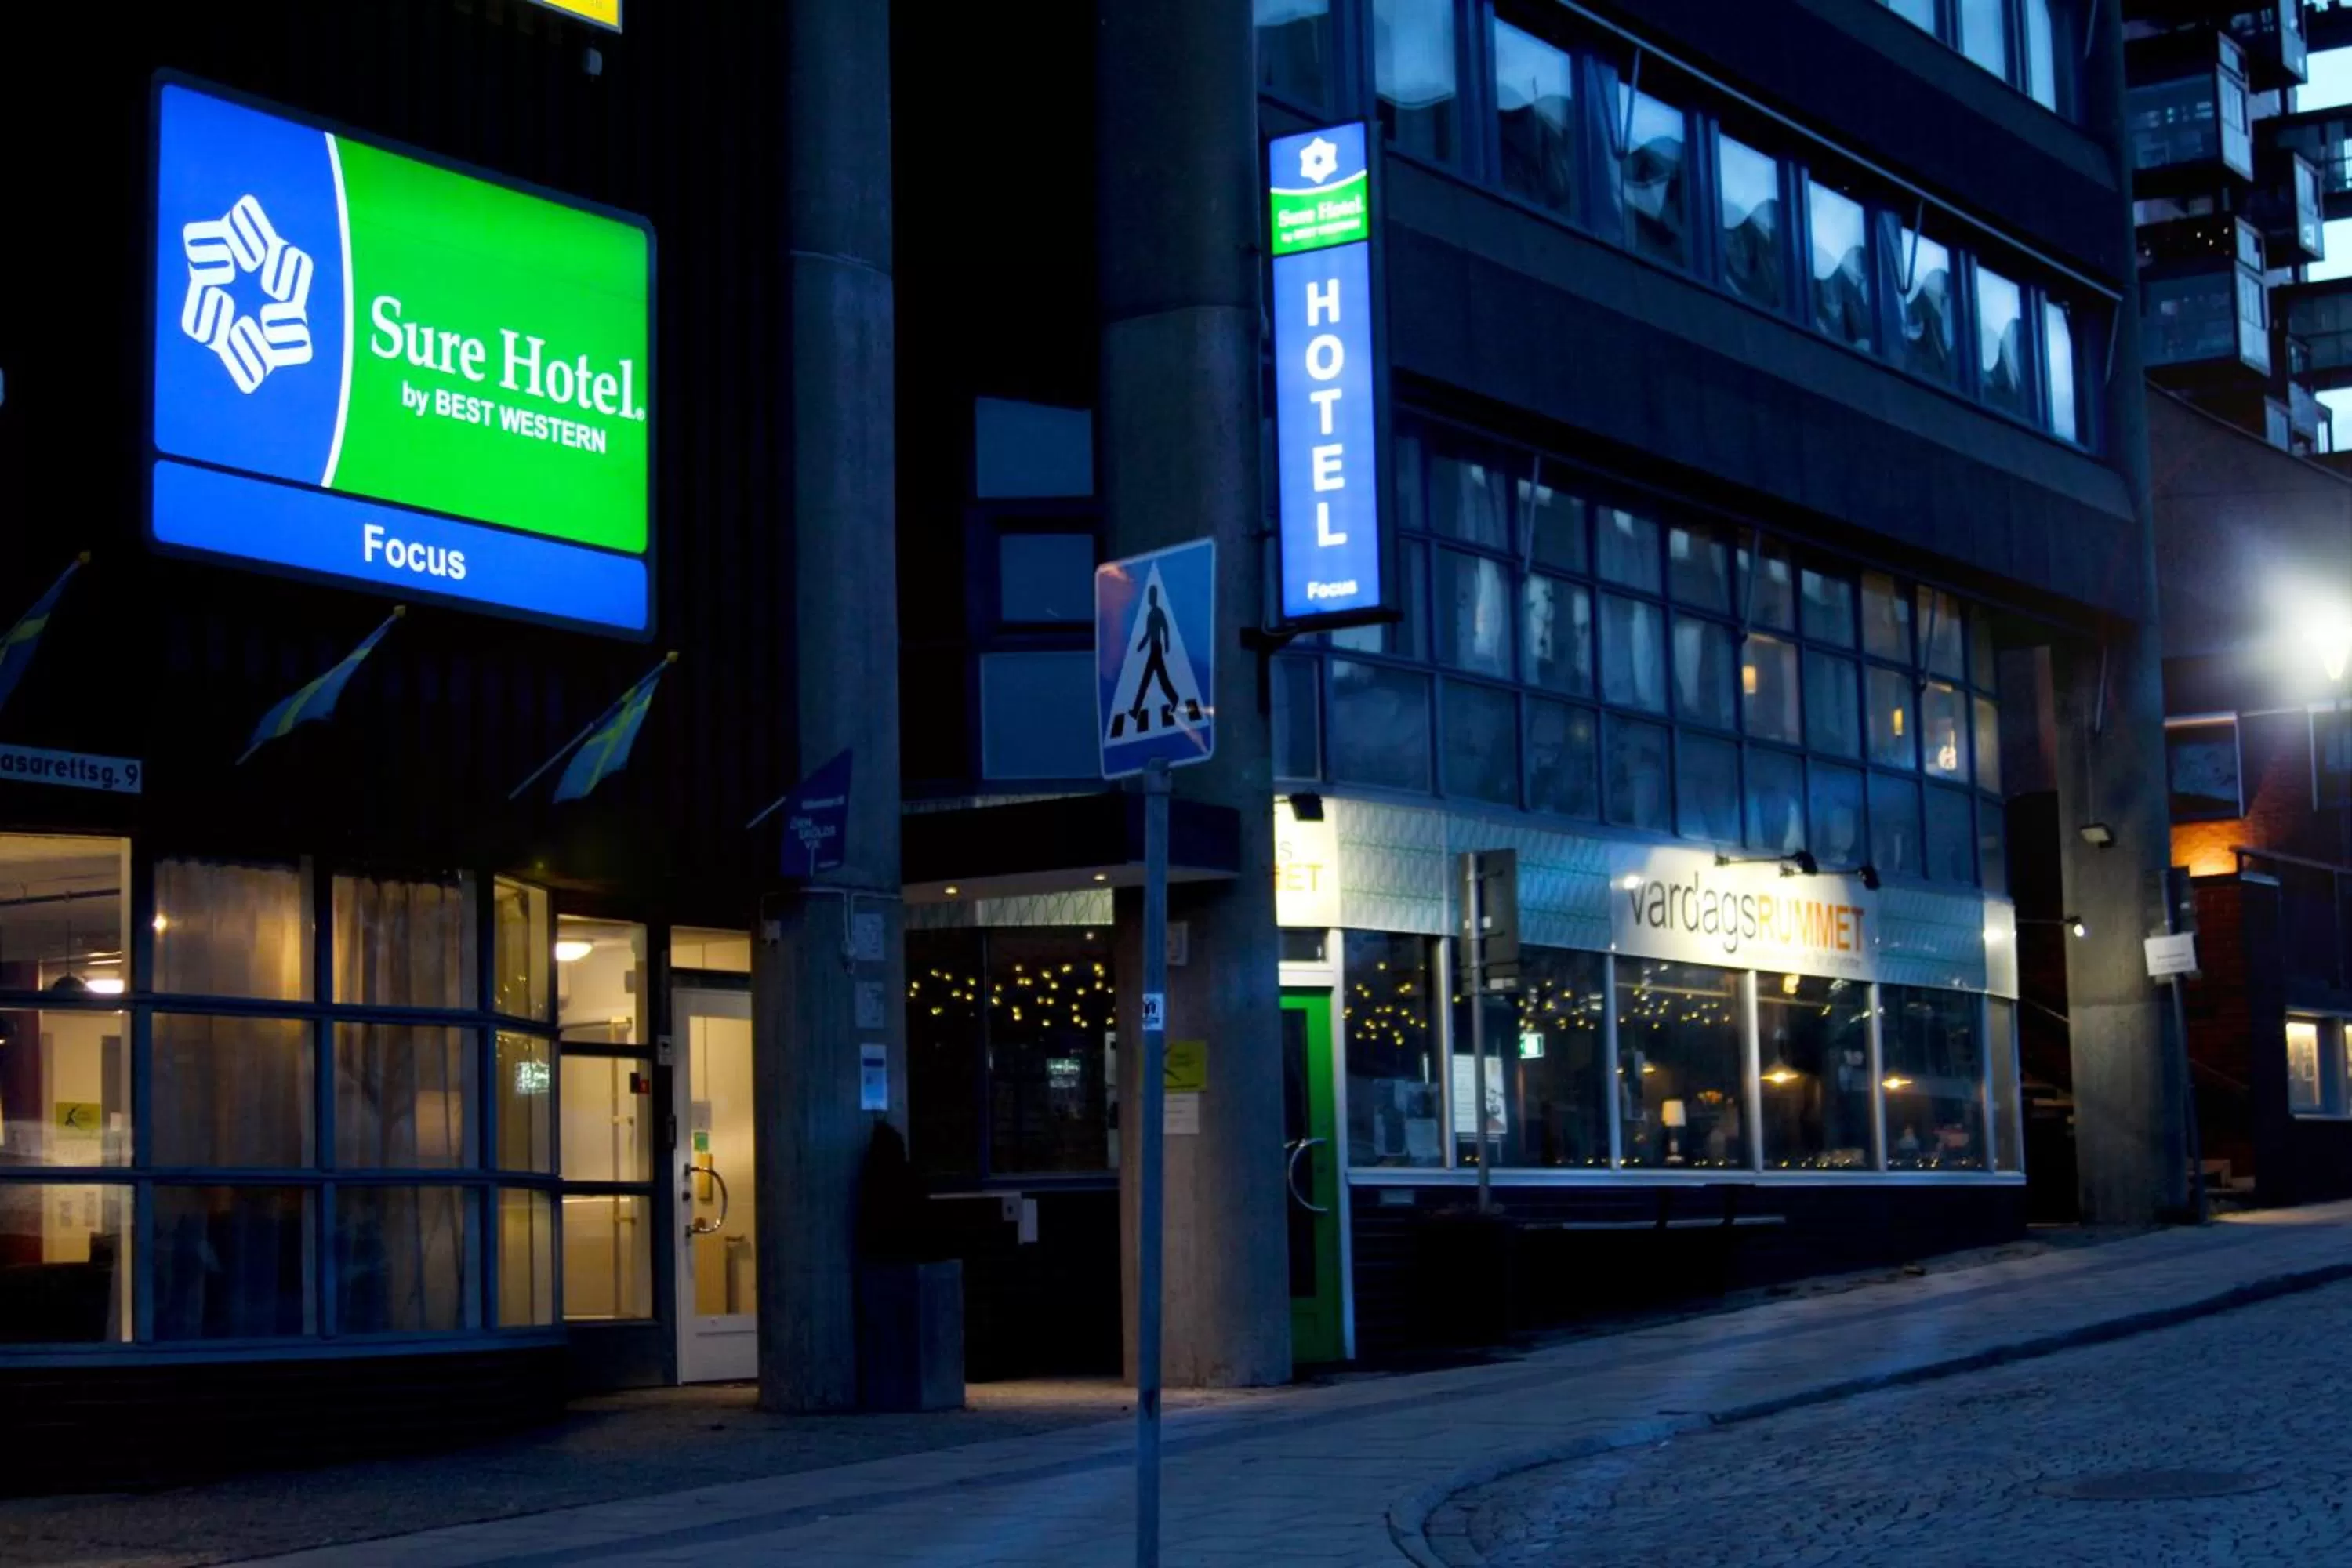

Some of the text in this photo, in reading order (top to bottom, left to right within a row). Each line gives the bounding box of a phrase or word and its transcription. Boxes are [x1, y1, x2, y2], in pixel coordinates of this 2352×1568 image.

[371, 295, 486, 382] Sure
[401, 379, 606, 454] by BEST WESTERN
[1305, 278, 1347, 547] HOTEL
[364, 523, 466, 580] Focus
[125, 764, 139, 786] 9
